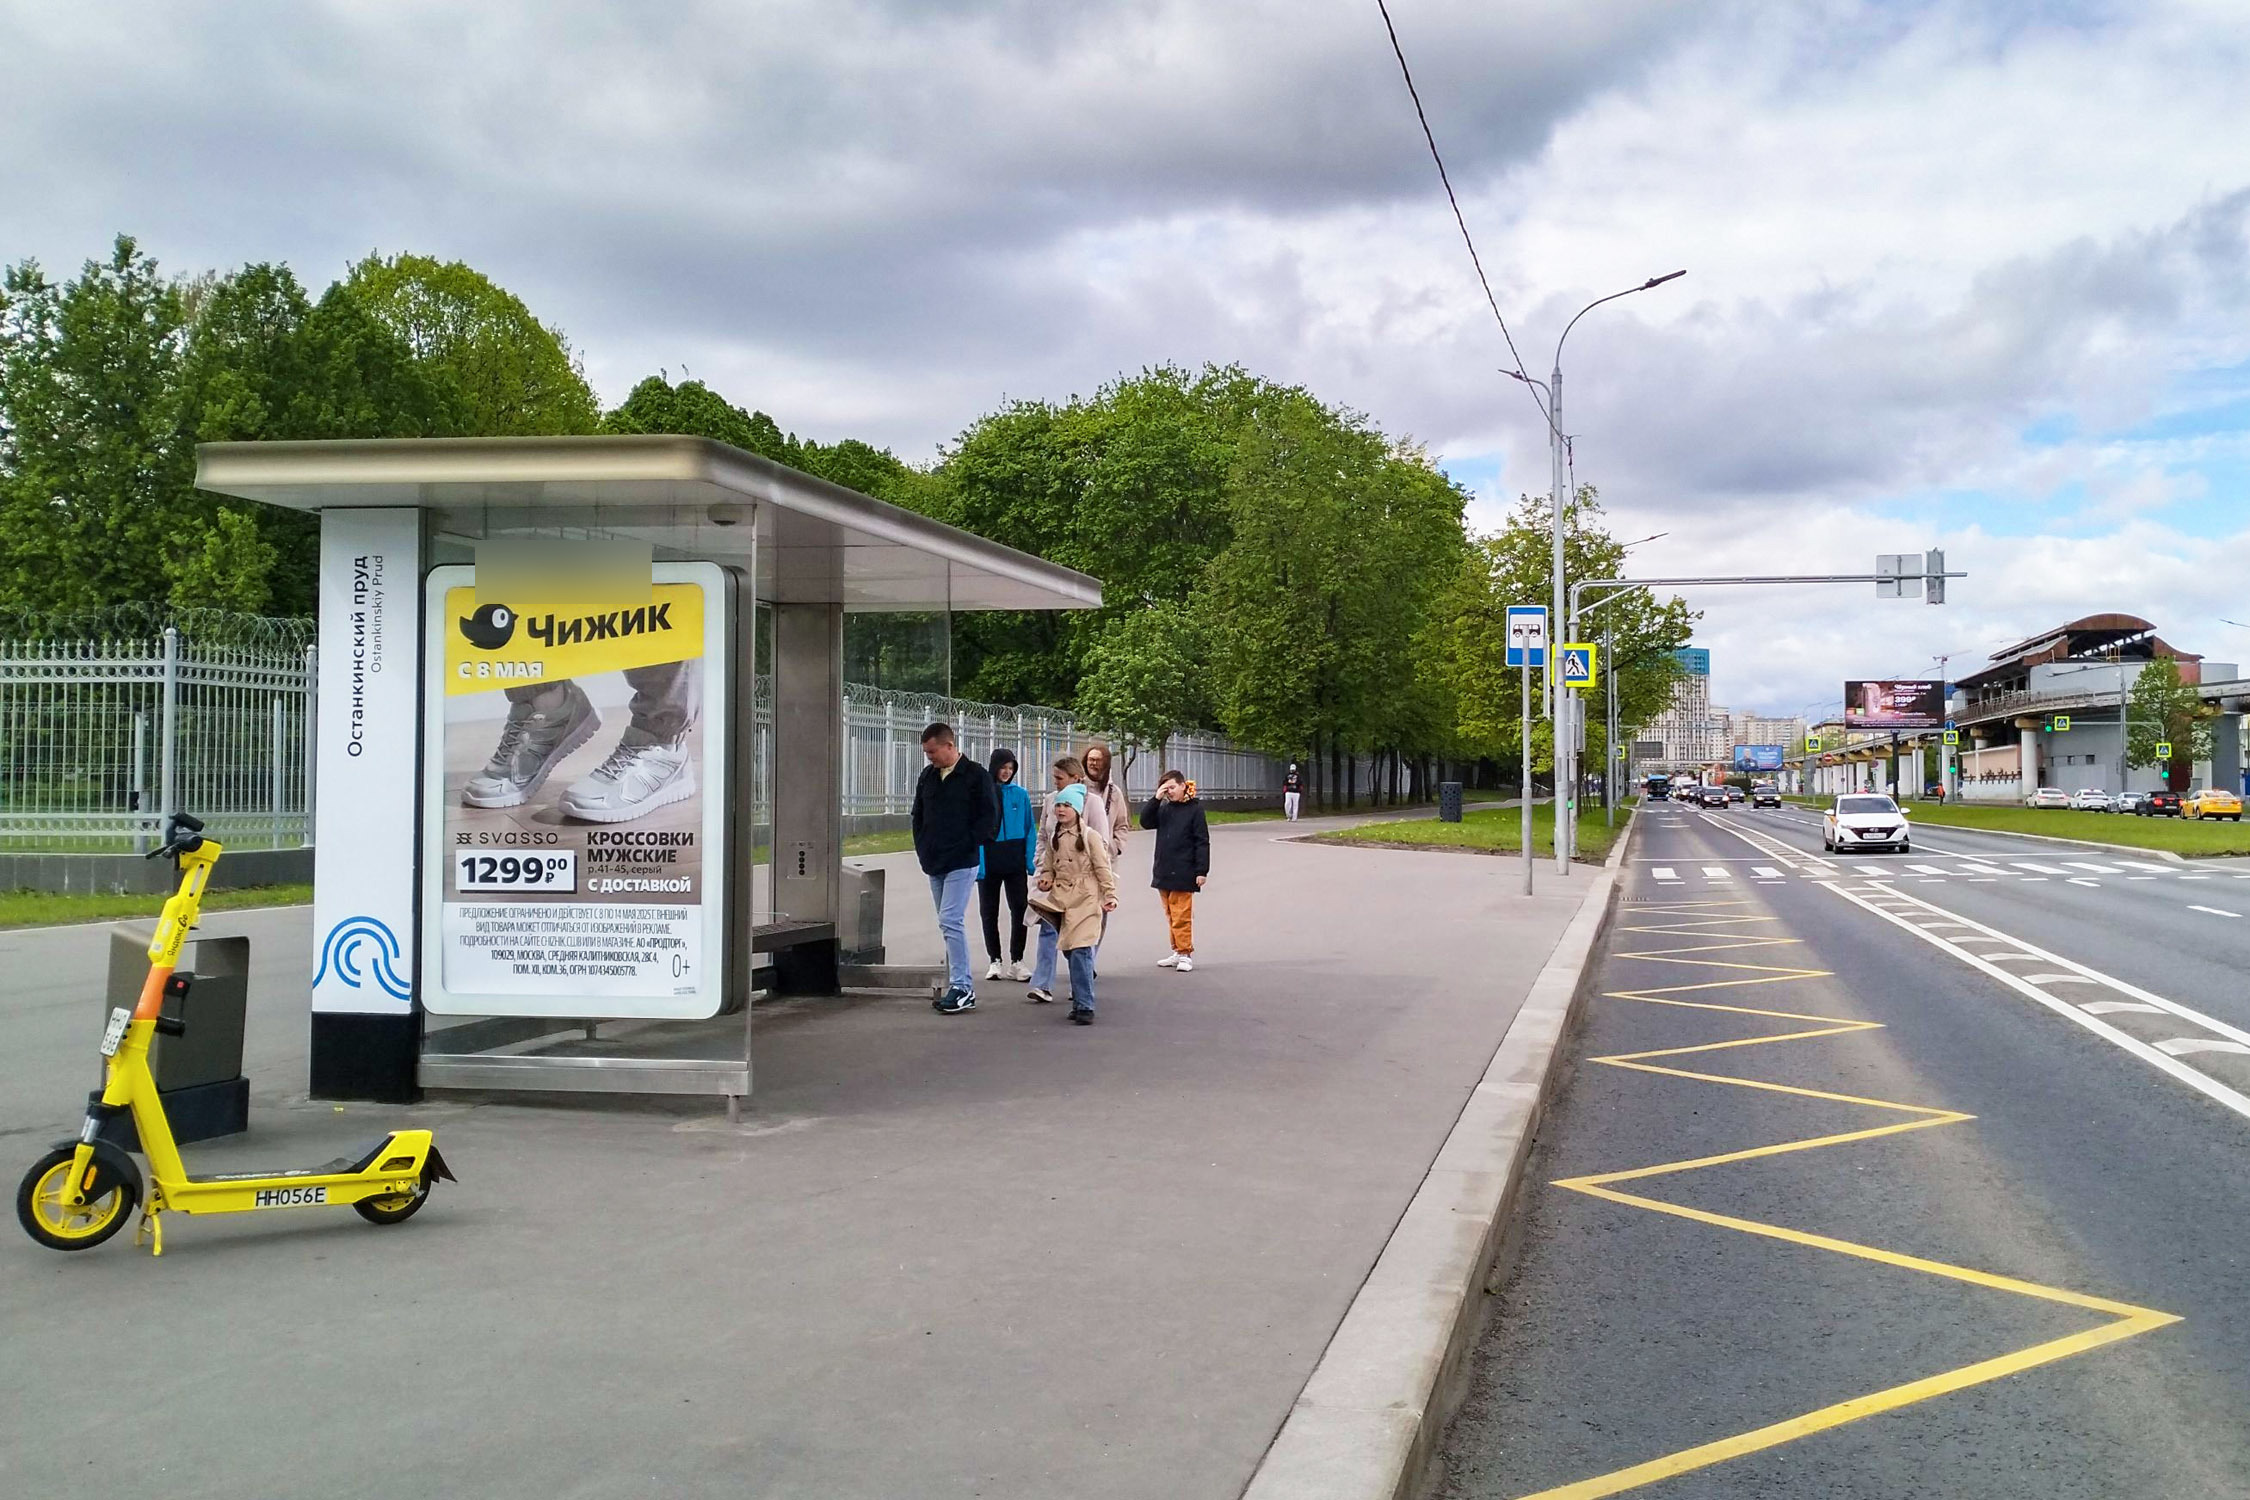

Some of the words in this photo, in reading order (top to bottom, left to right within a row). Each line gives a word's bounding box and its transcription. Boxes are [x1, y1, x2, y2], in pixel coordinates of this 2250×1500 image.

[372, 555, 383, 586] Prud
[354, 556, 369, 605] пруд
[371, 589, 384, 673] Ostankinskiy
[458, 661, 472, 679] С
[477, 661, 490, 678] 8
[495, 661, 544, 679] МАЯ
[347, 611, 365, 757] Останкинский
[587, 832, 694, 846] КРОССОВКИ
[587, 848, 677, 863] МУЖСКИЕ
[461, 857, 544, 884] 1299
[631, 865, 662, 875] серый
[587, 879, 598, 892] С
[600, 876, 692, 894] ДОСТАВКОЙ
[459, 907, 508, 919] ПРЕДЛОЖЕНИЕ
[509, 907, 551, 919] ОГРАНИЧЕНО
[558, 906, 593, 920] ДЕЙСТВУЕТ
[605, 908, 614, 919] ПО
[623, 909, 637, 919] МАЯ
[637, 909, 652, 920] 2025
[657, 907, 688, 921] ВНЕШНИЙ
[476, 921, 490, 933] ВИД
[491, 921, 516, 932] ТОВАРА
[516, 922, 540, 932] МОЖЕТ
[541, 922, 580, 933] ОТЛИЧАТЬСЯ
[581, 922, 590, 933] ОТ
[591, 920, 637, 934] ИЗОБРАЖЕНИЙ
[459, 935, 508, 948] ПОДРОБНОСТИ
[510, 935, 520, 946] НА
[520, 933, 541, 947] САЙТЕ
[582, 936, 596, 947] ИЛИ
[636, 937, 646, 948] АО
[517, 950, 547, 962] МОСКВА,
[548, 950, 578, 963] СРЕДНЯЯ
[569, 964, 586, 976] ОГРН
